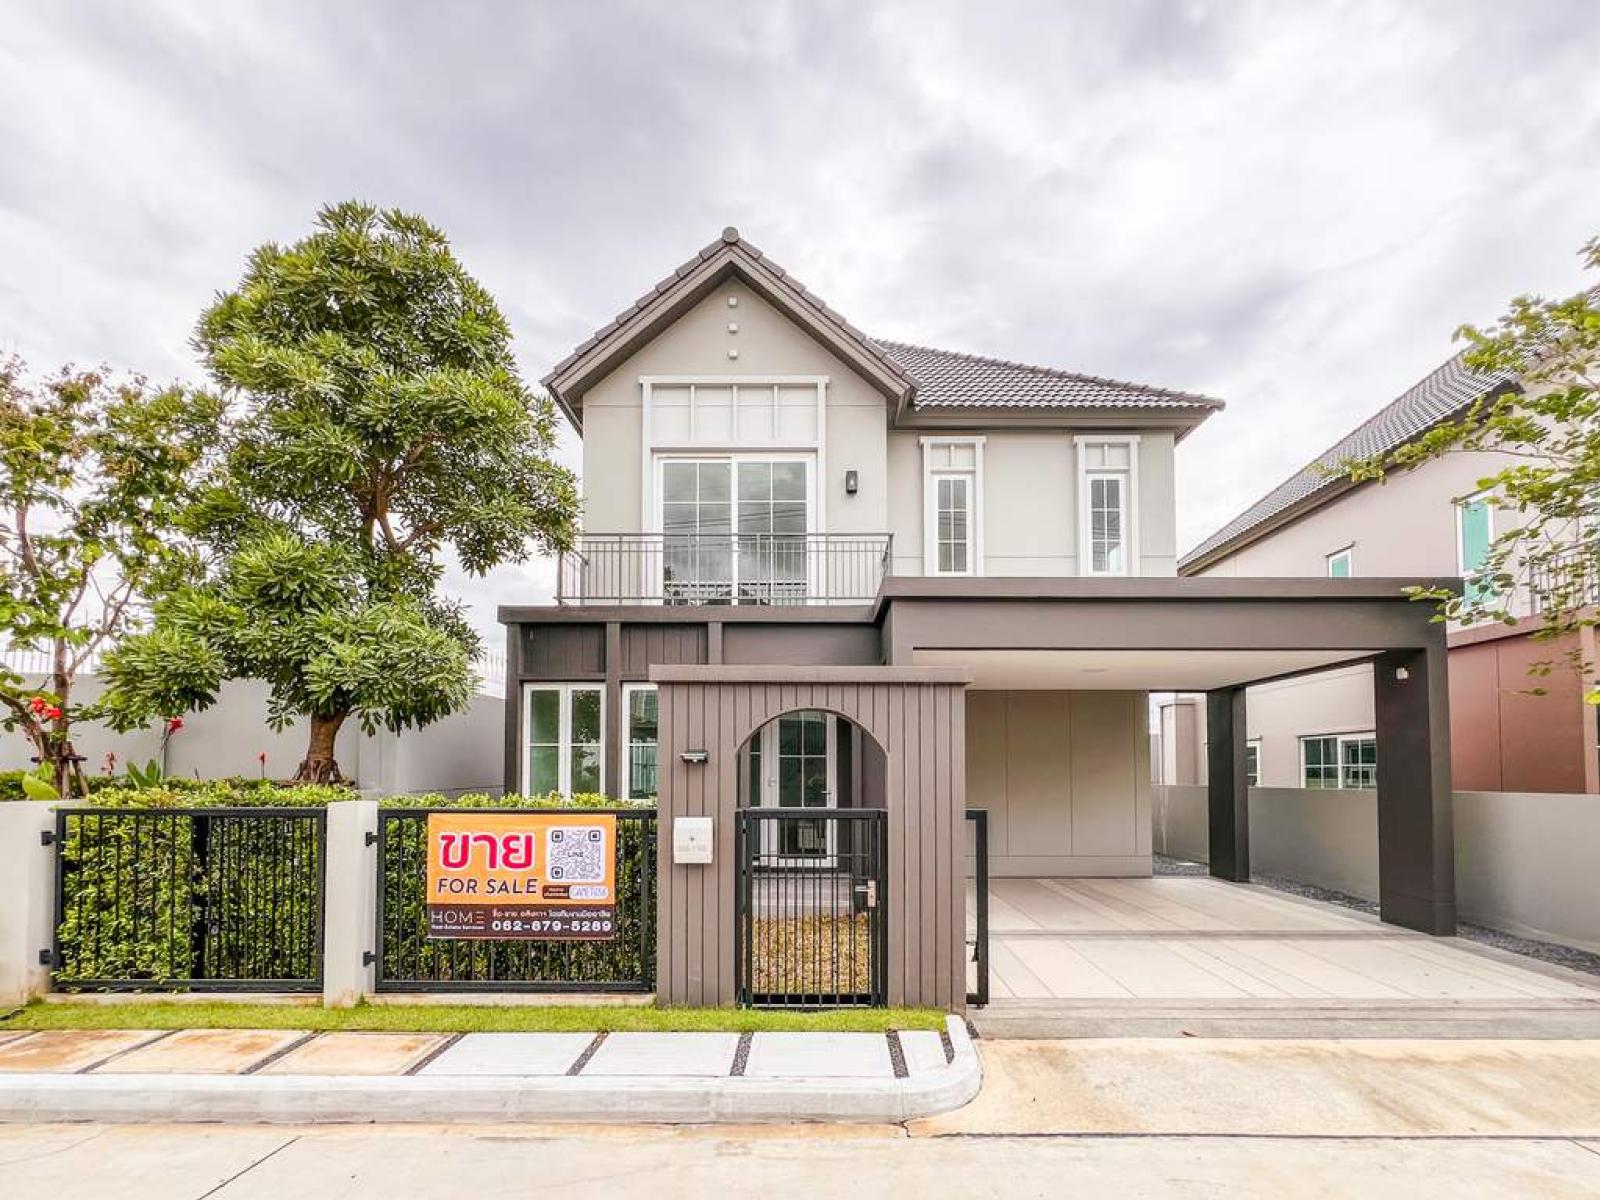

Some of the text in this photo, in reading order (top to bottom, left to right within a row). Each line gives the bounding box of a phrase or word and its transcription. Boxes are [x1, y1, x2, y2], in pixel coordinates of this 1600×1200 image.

[440, 833, 534, 869] ขาย
[437, 878, 539, 894] FOR SALE
[431, 910, 485, 924] HOME
[491, 920, 612, 932] 062-879-5289
